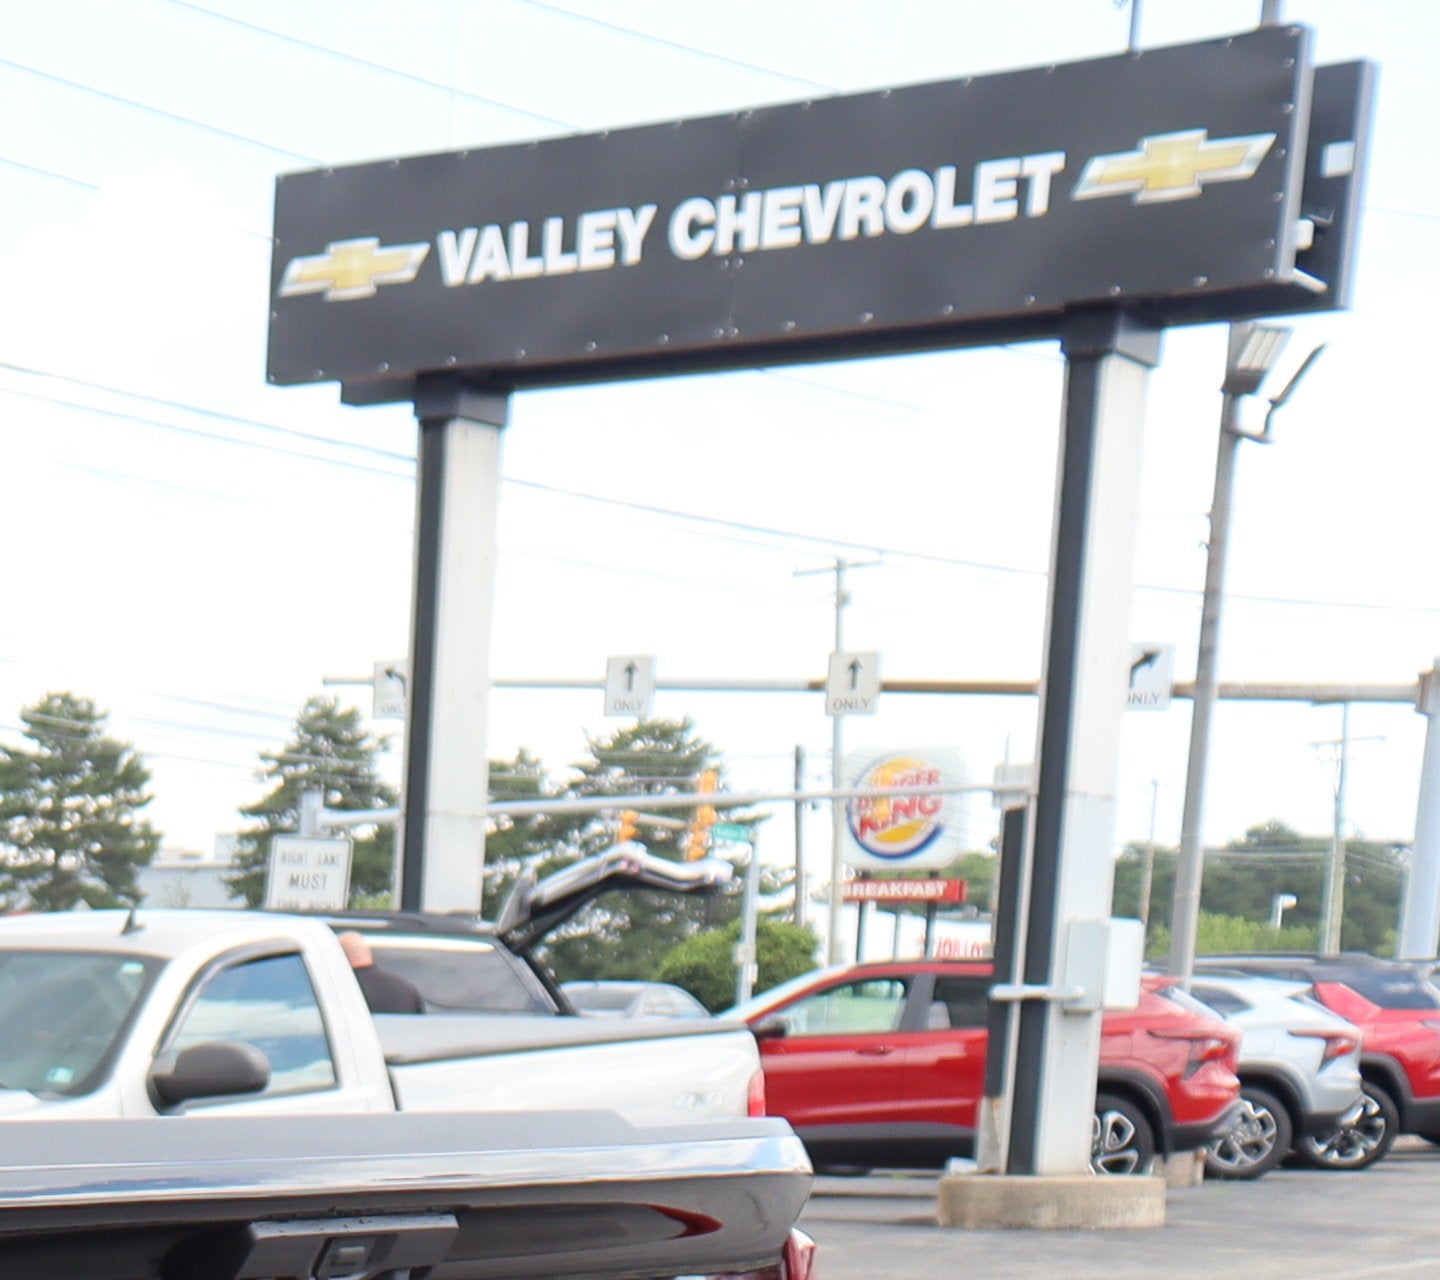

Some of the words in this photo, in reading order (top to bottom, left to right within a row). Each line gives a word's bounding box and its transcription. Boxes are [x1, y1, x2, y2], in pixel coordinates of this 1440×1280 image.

[437, 203, 657, 288] VALLEY
[668, 150, 1067, 264] CHEVROLET
[613, 700, 643, 712] ONLY
[832, 698, 872, 711] ONLY
[289, 872, 330, 889] MUST
